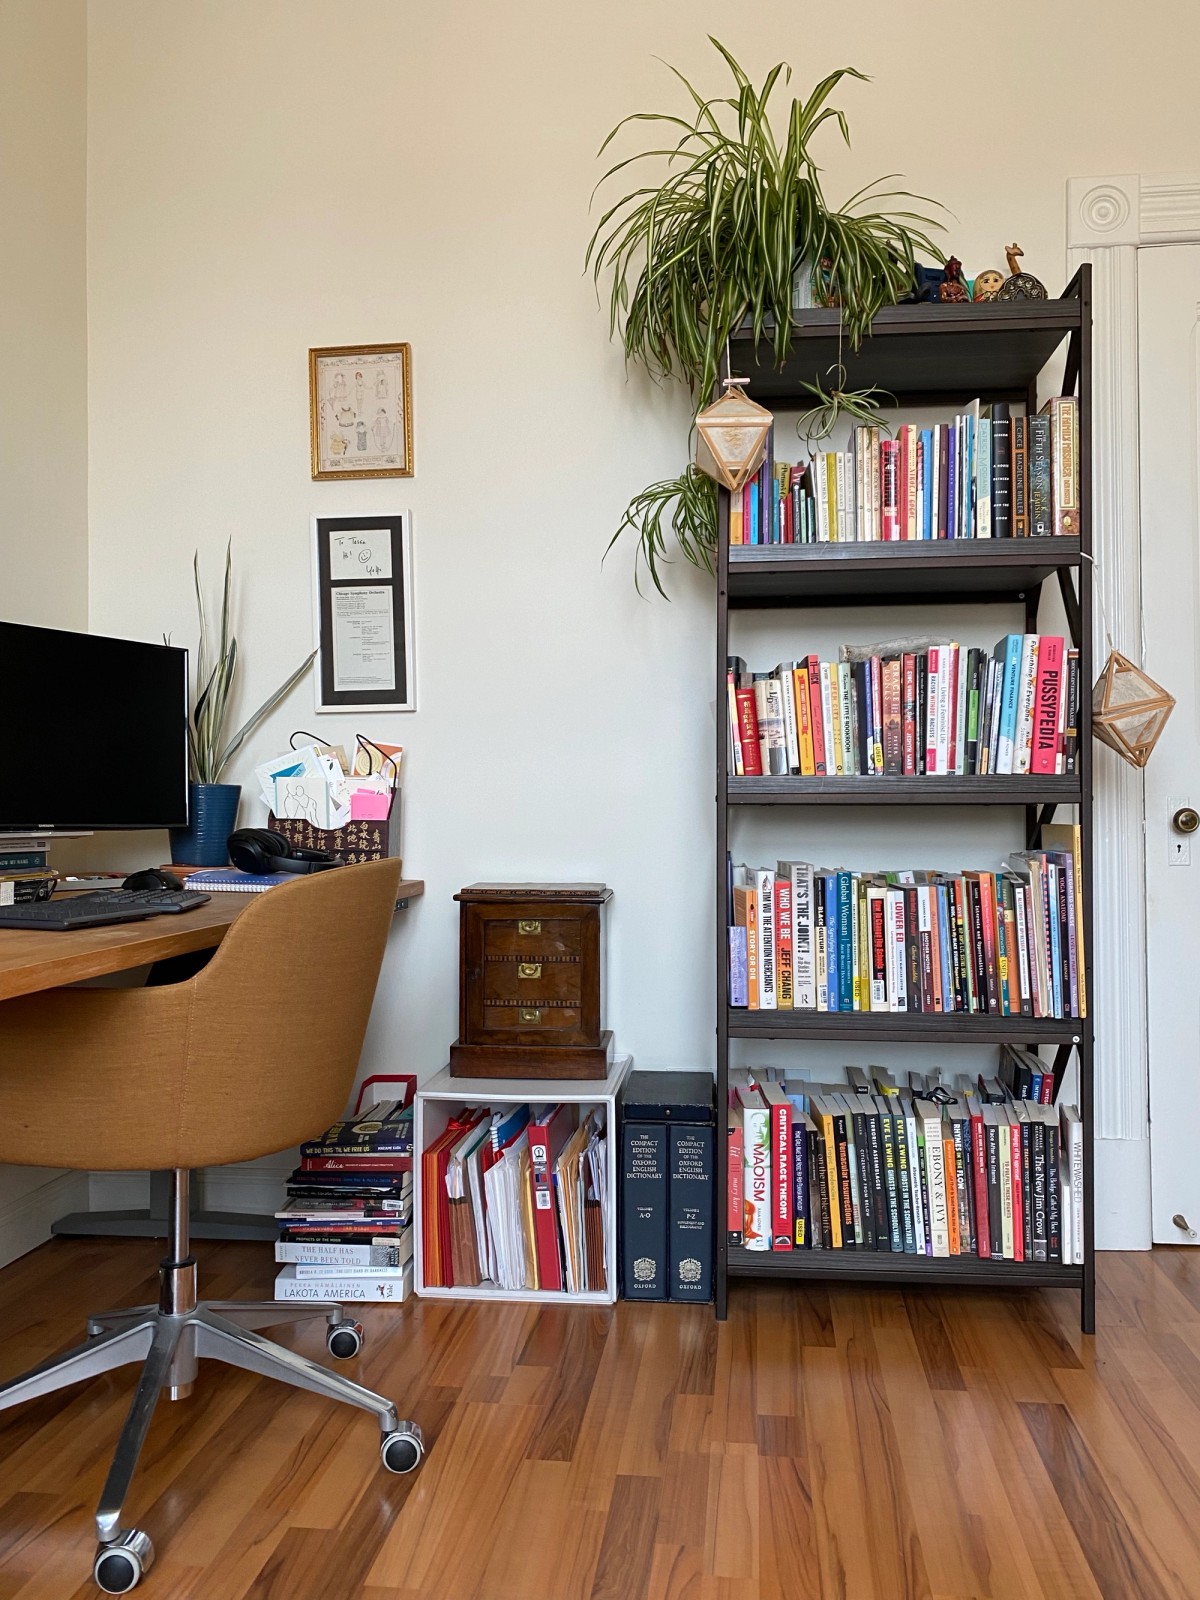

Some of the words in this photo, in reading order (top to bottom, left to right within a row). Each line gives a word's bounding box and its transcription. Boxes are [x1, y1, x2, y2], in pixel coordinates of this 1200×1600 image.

[1036, 430, 1044, 453] FIFTH
[1036, 456, 1046, 489] SEASON
[1027, 641, 1036, 678] Everything
[1023, 690, 1032, 722] Everyone
[1038, 670, 1058, 750] PUSSYPEDIA
[797, 865, 809, 898] THAT'S
[840, 876, 848, 903] Global
[763, 891, 772, 901] TIM
[780, 888, 789, 908] WHO
[763, 903, 772, 913] WU
[781, 912, 790, 925] WE
[797, 901, 809, 919] THE
[895, 901, 903, 930] LOWER
[763, 916, 772, 926] THE
[763, 927, 773, 957] ATTENTION
[781, 928, 790, 939] BE
[797, 921, 809, 953] JOINT!
[896, 932, 903, 942] ED
[750, 956, 756, 966] OR
[781, 947, 791, 967] JEFF
[764, 958, 774, 992] MERCHANTS
[782, 970, 791, 999] CHANG
[730, 1146, 740, 1157] lit
[818, 1154, 823, 1164] on
[840, 1142, 848, 1178] Vernacular
[323, 1160, 344, 1168] Alice
[753, 1143, 765, 1201] MAOISM
[932, 1146, 942, 1187] EBONY
[1036, 1155, 1044, 1171] The
[1073, 1142, 1082, 1203] WHITEWASHED
[1036, 1173, 1044, 1192] New
[820, 1181, 828, 1210] marble
[842, 1180, 852, 1224] Insurrections
[936, 1191, 942, 1200] &
[1035, 1193, 1046, 1209] Jim
[822, 1212, 830, 1233] cliffs
[891, 1208, 900, 1242] SCHOOLYARD
[936, 1204, 945, 1224] IVY
[1037, 1210, 1045, 1235] Crow
[284, 1289, 319, 1297] LAKOTA
[324, 1289, 365, 1298] AMERICA
